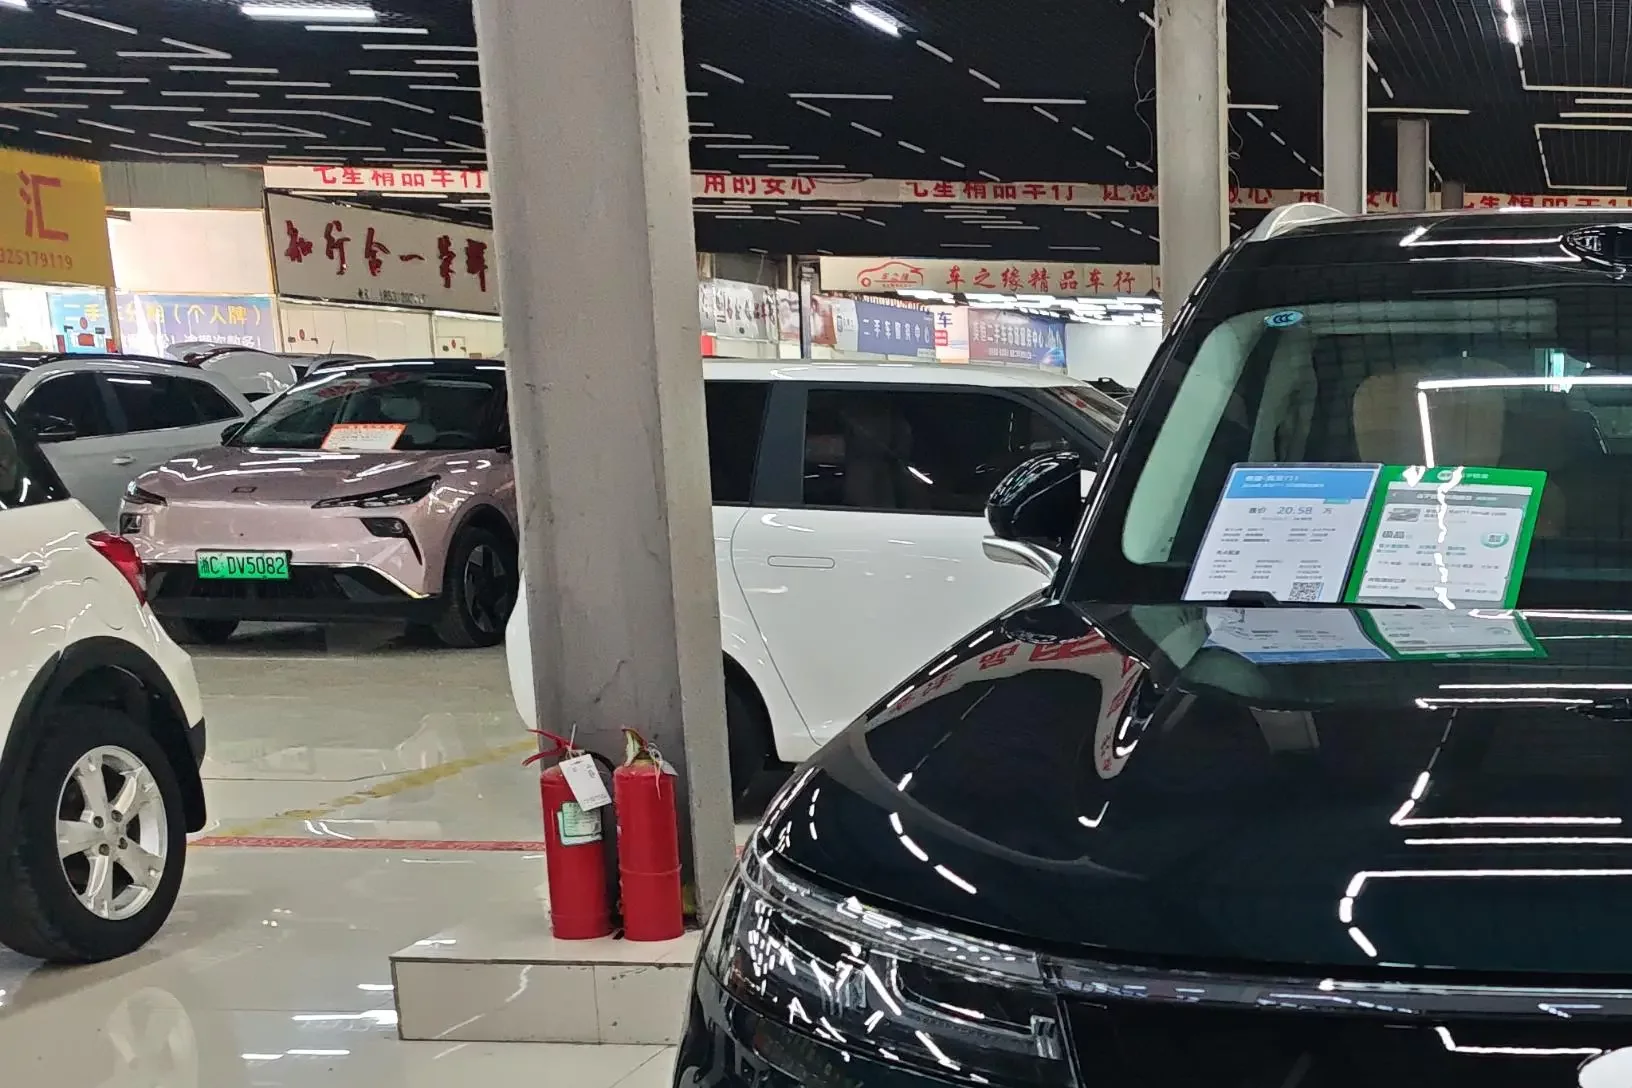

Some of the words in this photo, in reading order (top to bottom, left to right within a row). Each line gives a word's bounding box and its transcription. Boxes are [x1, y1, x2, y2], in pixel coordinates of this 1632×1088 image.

[18, 170, 69, 241] 汇
[946, 265, 1136, 294] 车之缘精品车行
